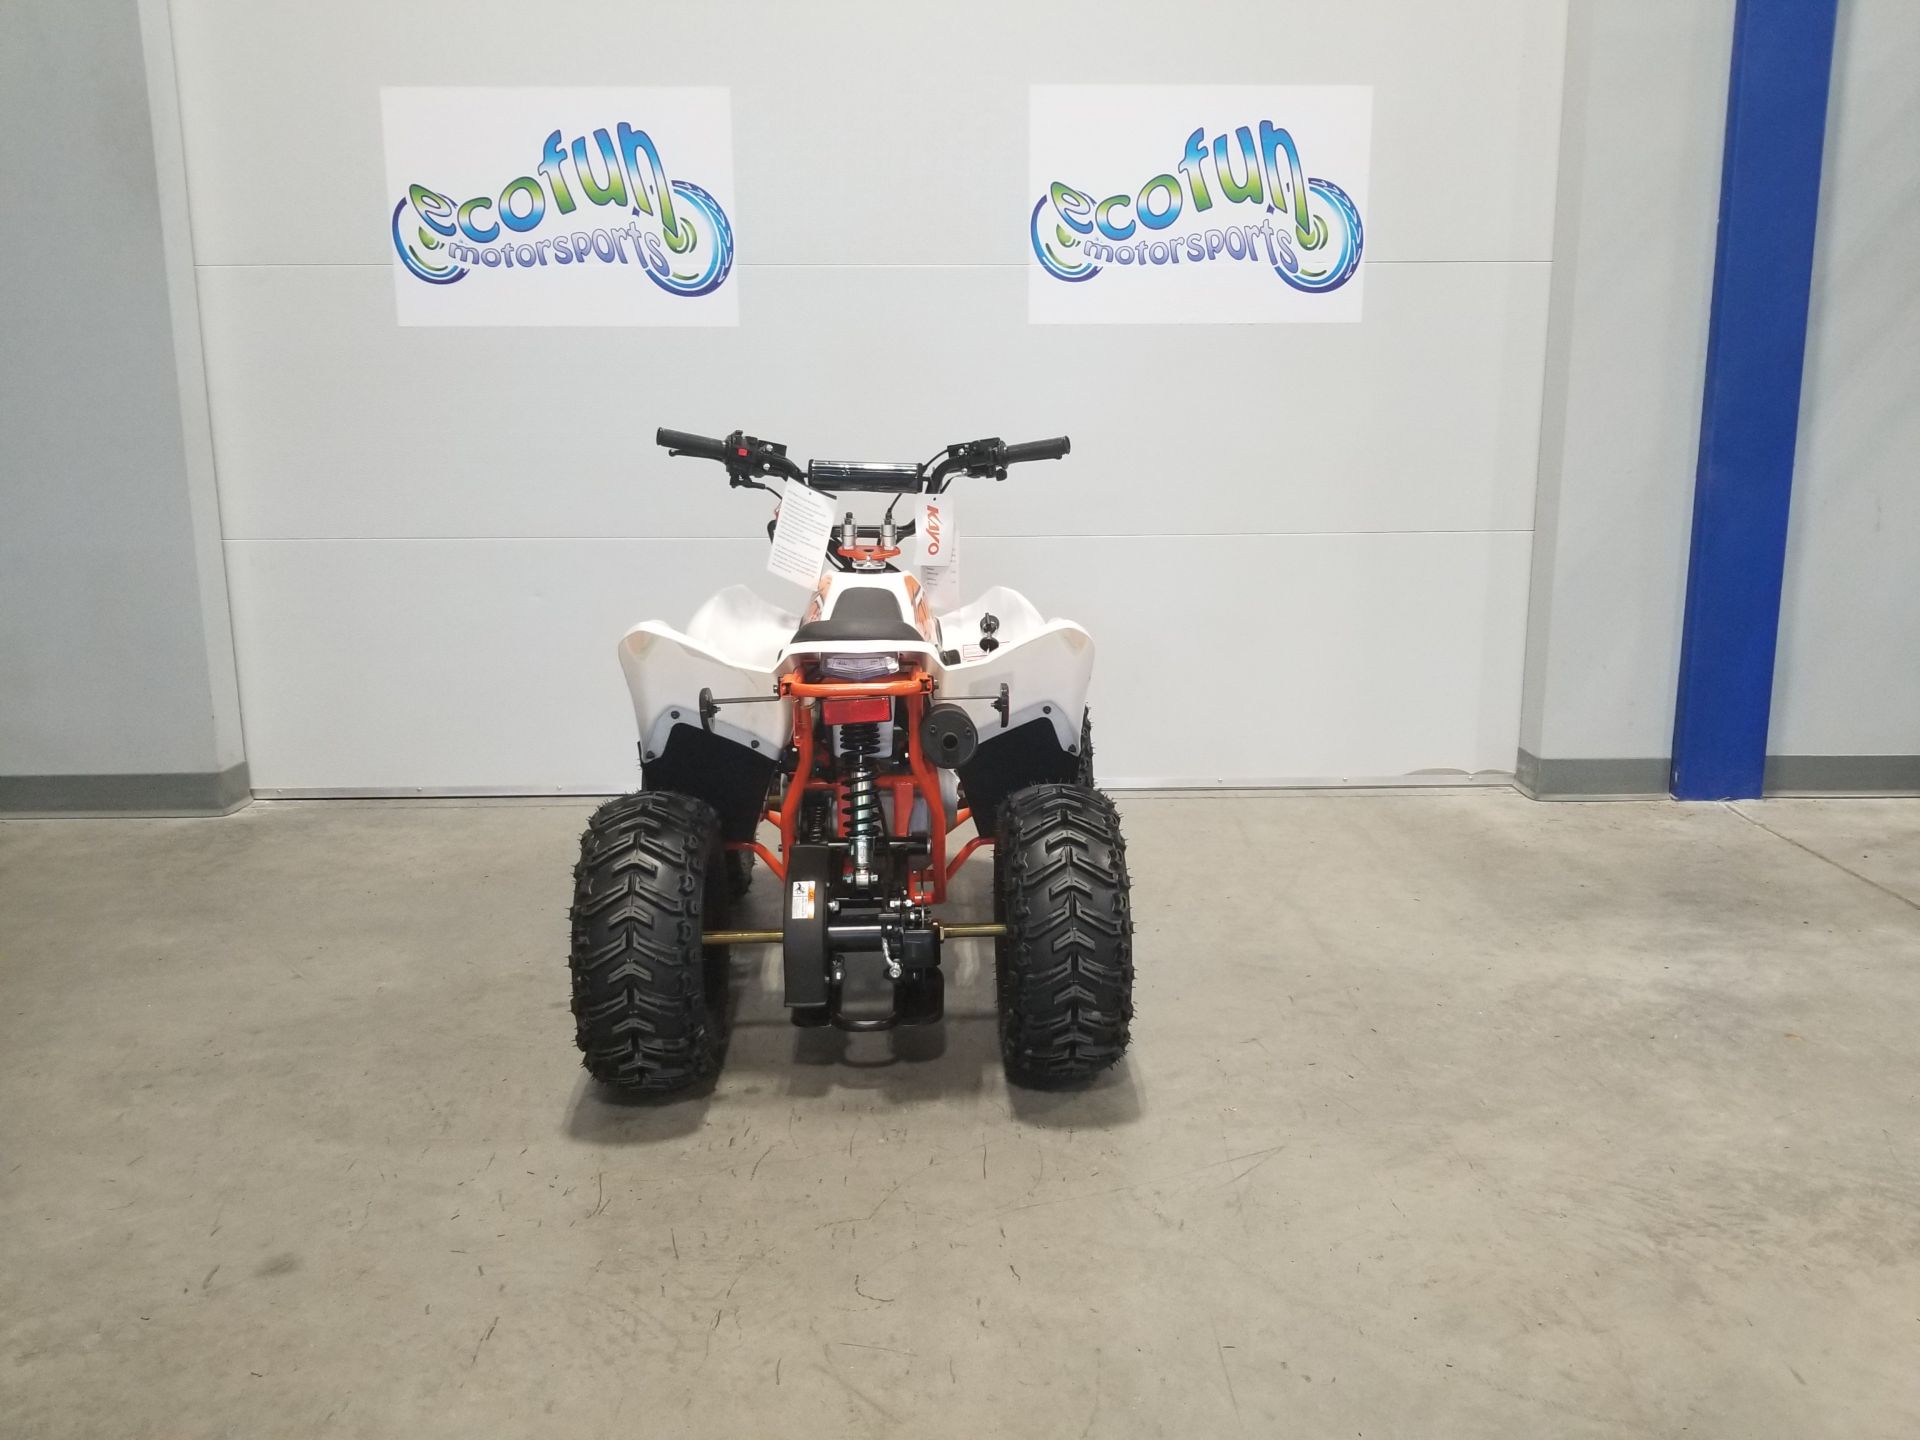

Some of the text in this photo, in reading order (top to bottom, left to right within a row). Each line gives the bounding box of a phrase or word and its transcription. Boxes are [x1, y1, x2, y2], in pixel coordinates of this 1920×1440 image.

[449, 222, 671, 277] motorsports
[1084, 219, 1299, 274] motorsports
[926, 505, 943, 555] KAYO
